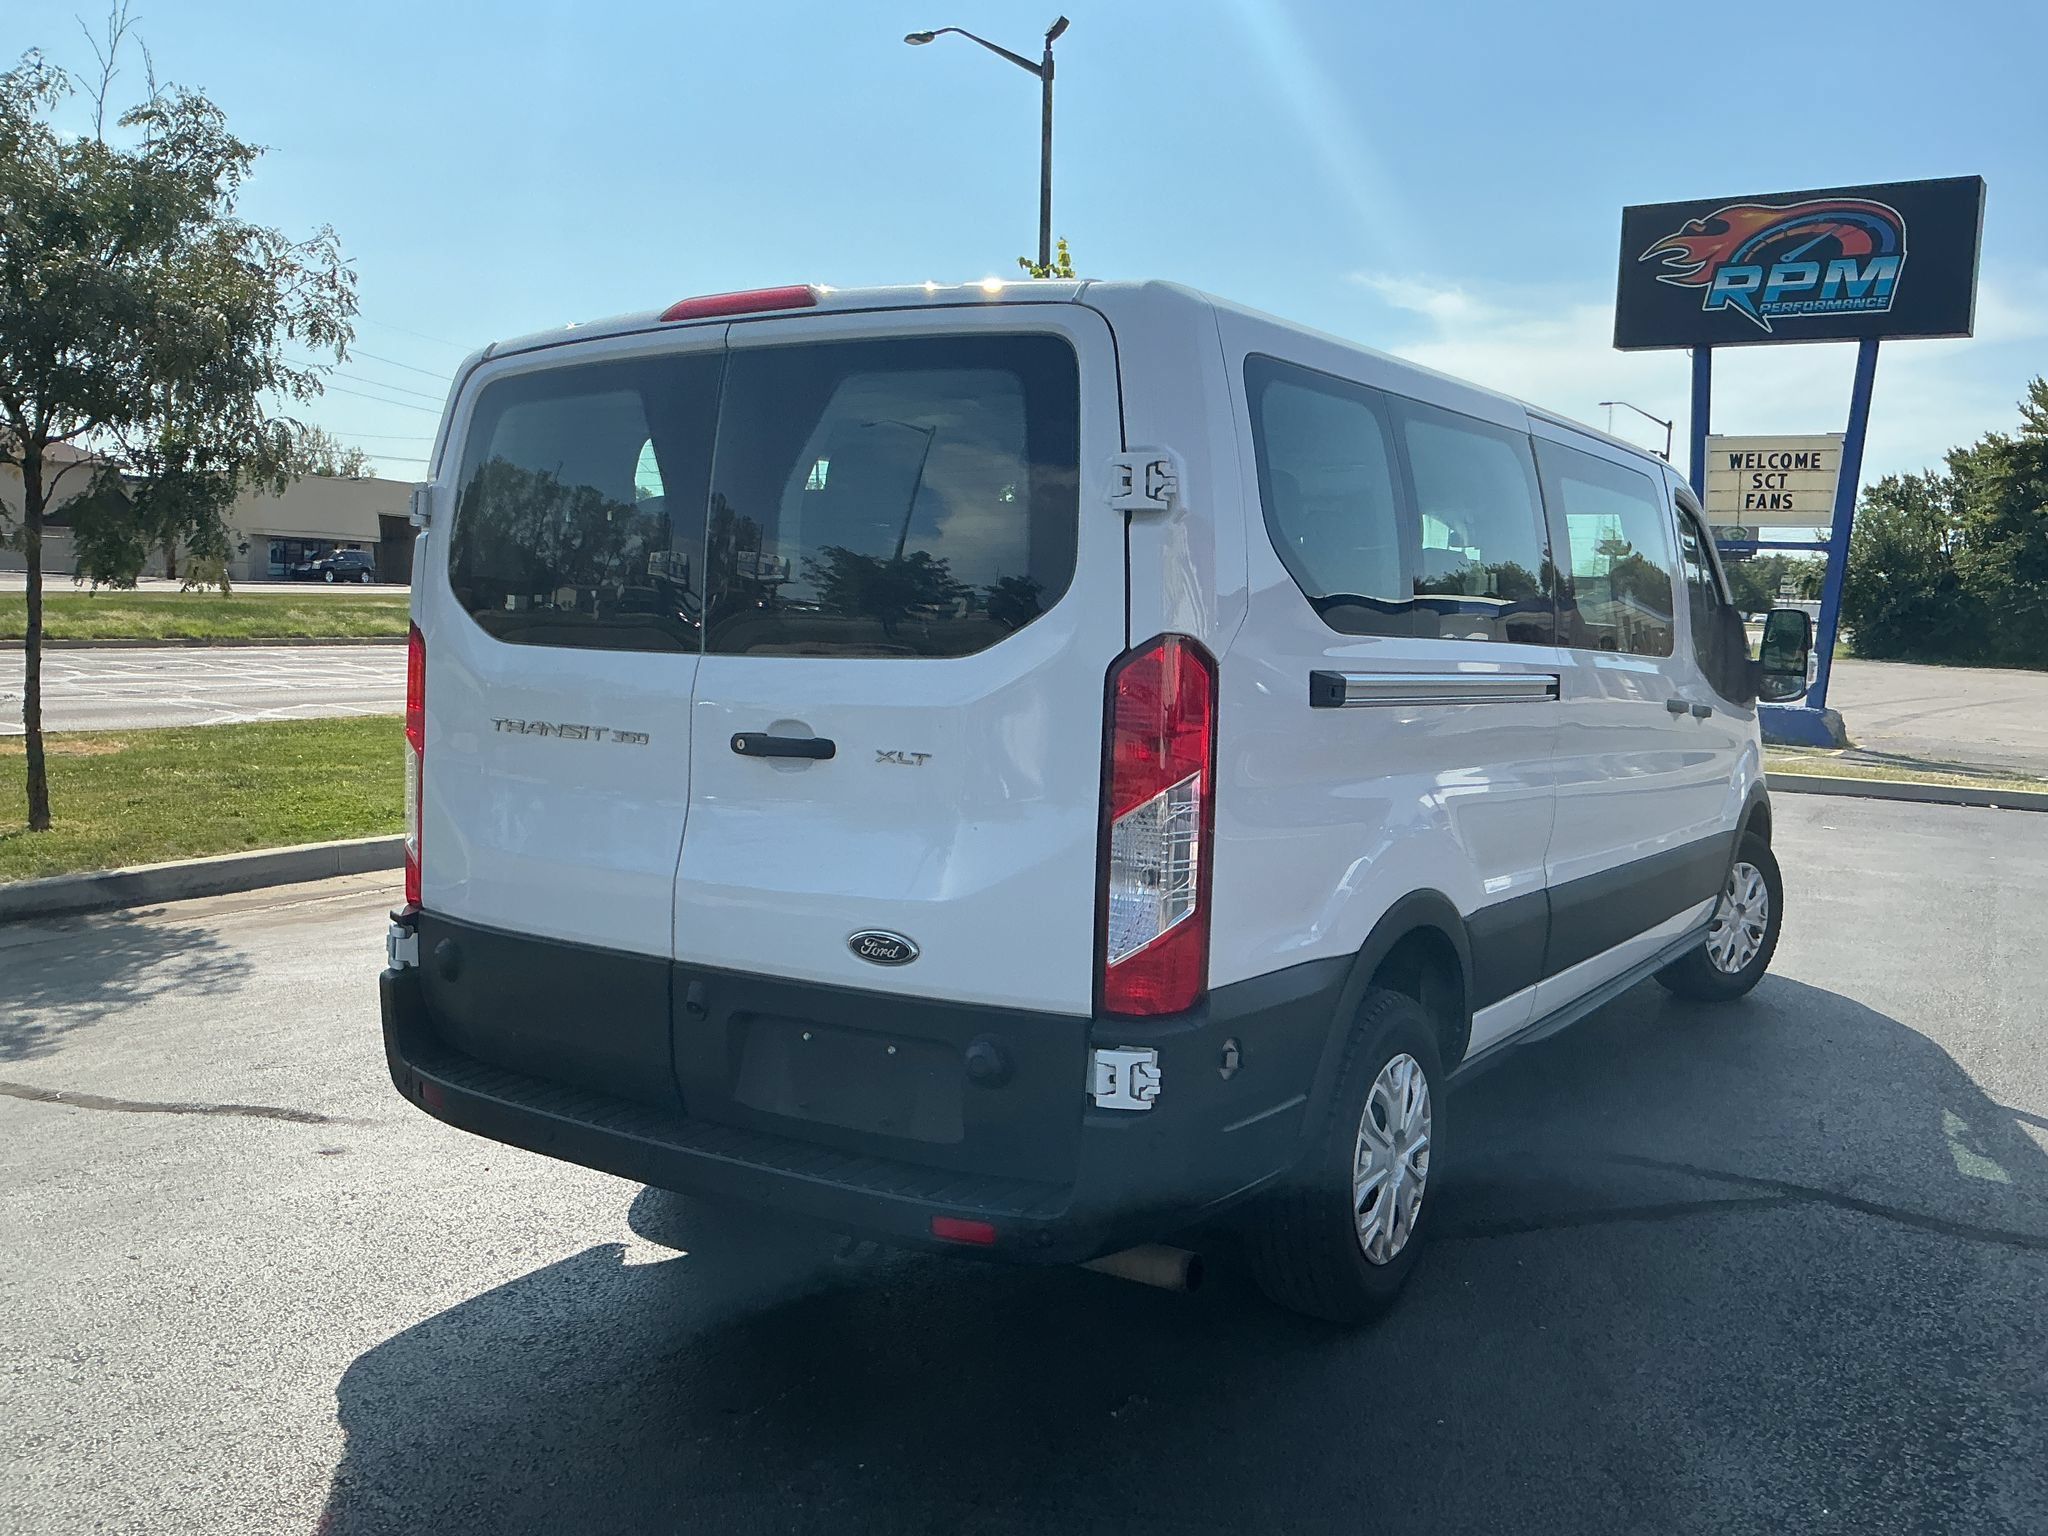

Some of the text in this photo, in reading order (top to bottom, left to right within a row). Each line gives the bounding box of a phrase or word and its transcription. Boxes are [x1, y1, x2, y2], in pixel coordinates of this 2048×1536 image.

[1709, 256, 1900, 317] RPM
[1759, 297, 1888, 313] PERFORMANCE
[1729, 452, 1821, 469] WELCOME
[1752, 473, 1788, 489] SCT
[1745, 493, 1793, 509] FANS
[491, 717, 650, 746] TRANSIT 350
[875, 749, 933, 766] XLT
[860, 937, 900, 959] Ford
